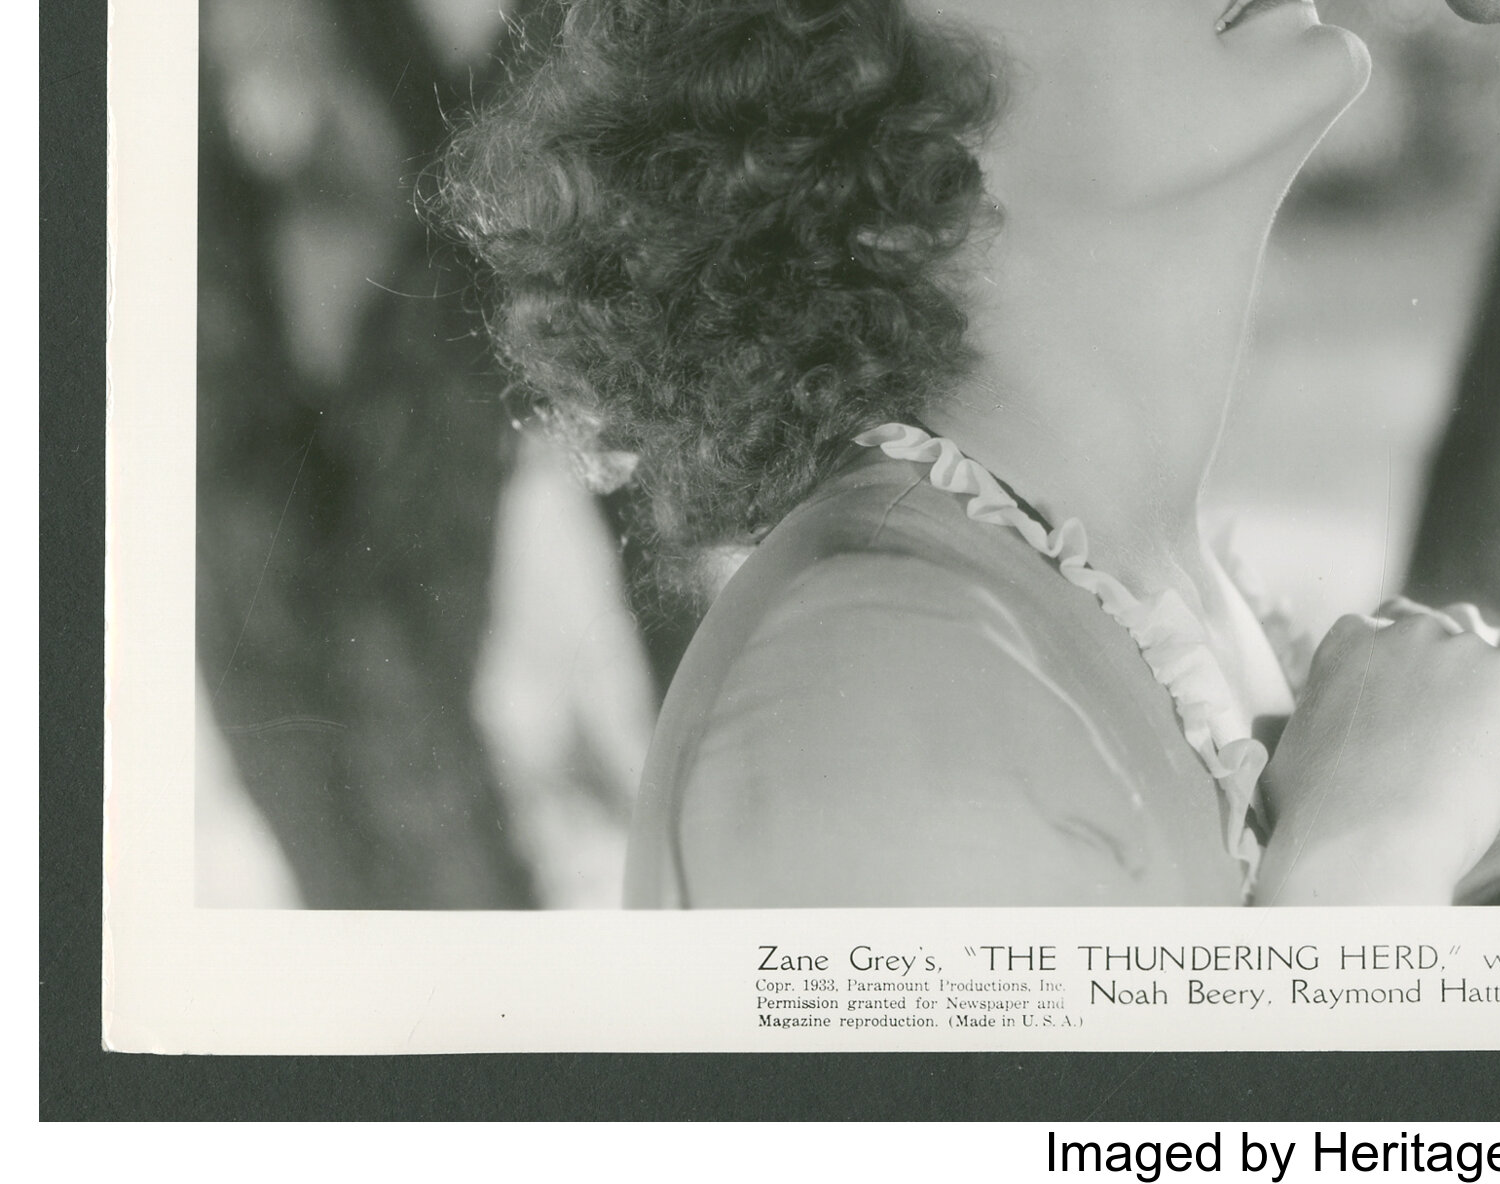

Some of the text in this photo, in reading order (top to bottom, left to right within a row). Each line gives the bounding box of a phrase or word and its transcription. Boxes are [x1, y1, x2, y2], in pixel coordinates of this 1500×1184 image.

[757, 945, 829, 972] Zane
[849, 945, 943, 977] Grey's,
[1077, 944, 1319, 972] THUNDERING
[755, 978, 795, 994] Copr.
[847, 978, 930, 992] Paramount
[1090, 979, 1168, 1005] Noah
[1291, 978, 1421, 1010] Raymond
[756, 995, 1065, 1012] Permission granted for Newspaper and
[758, 1013, 832, 1030] Magazine
[839, 1013, 939, 1030] reproduction.
[948, 1014, 996, 1029] (Made
[1001, 1014, 1016, 1028] in
